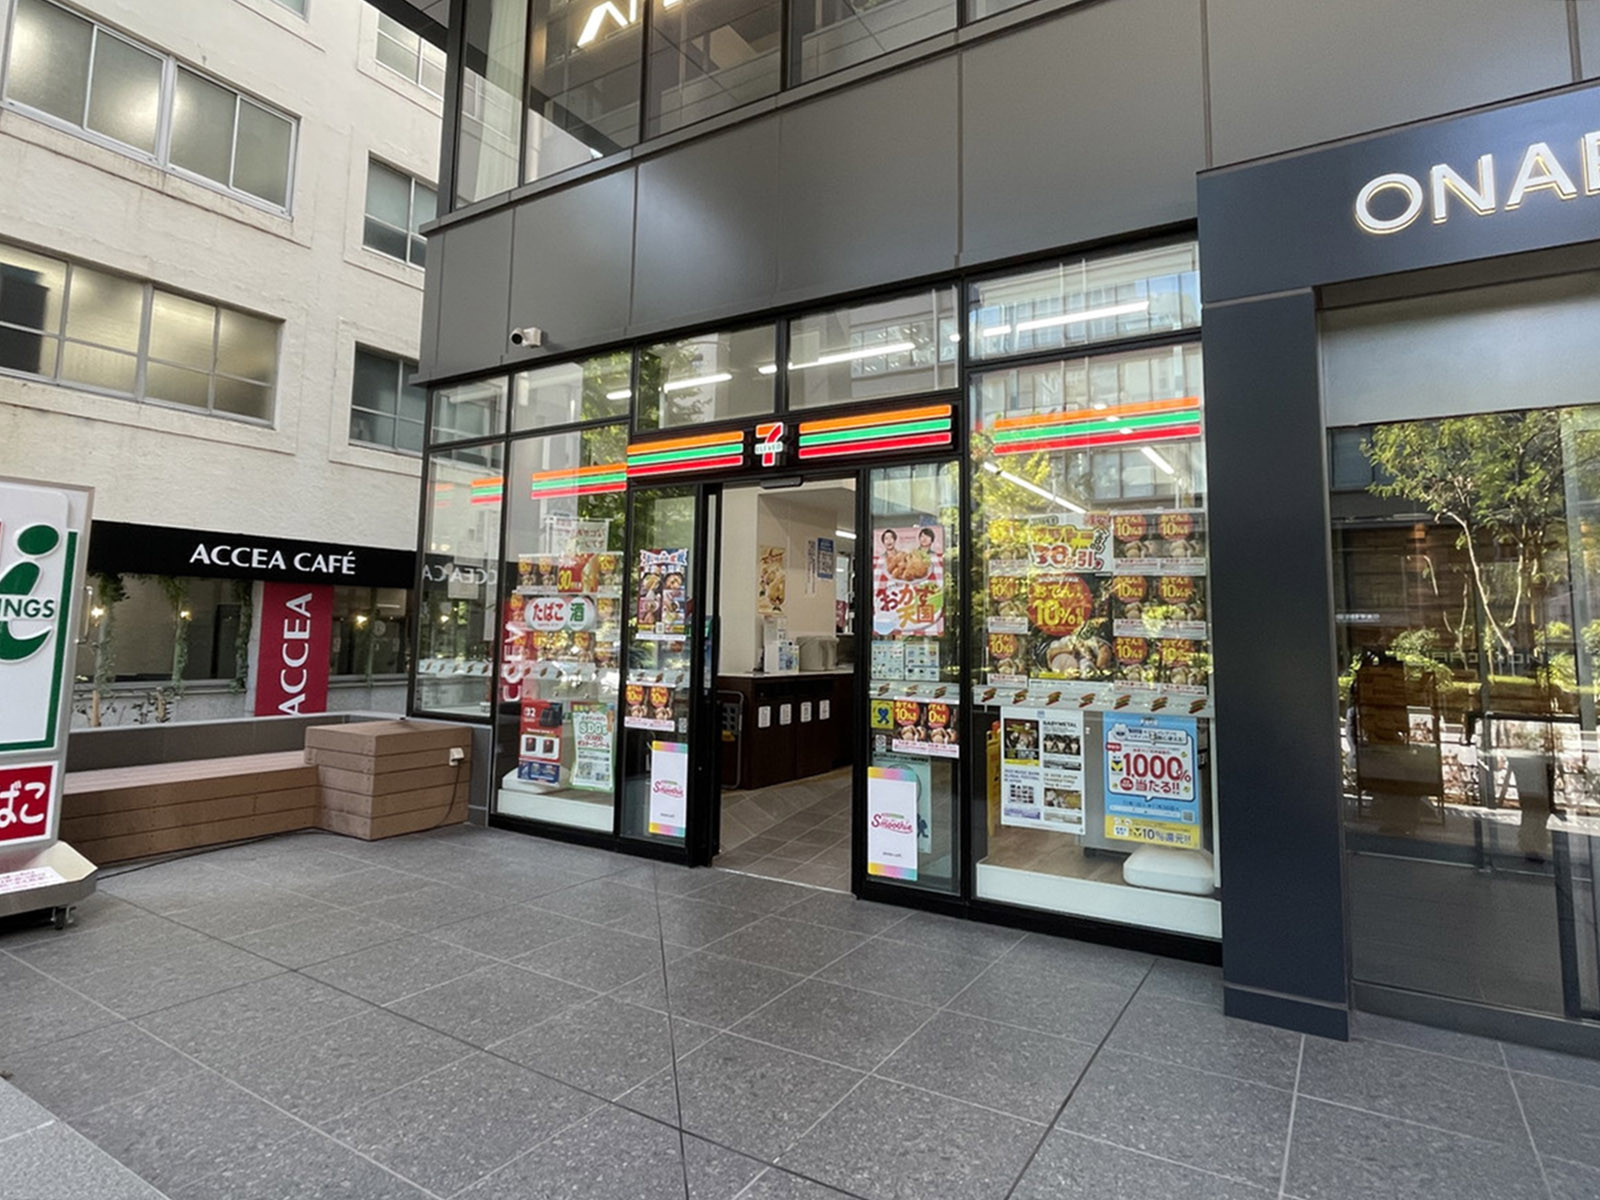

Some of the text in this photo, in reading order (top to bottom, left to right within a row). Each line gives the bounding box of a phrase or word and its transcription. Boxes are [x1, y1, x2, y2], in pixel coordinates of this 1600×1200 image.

[189, 543, 356, 575] ACCEA CAFÉ
[0, 598, 54, 618] NGS
[532, 602, 585, 622] たばこ 酒
[278, 592, 313, 717] ACCEA
